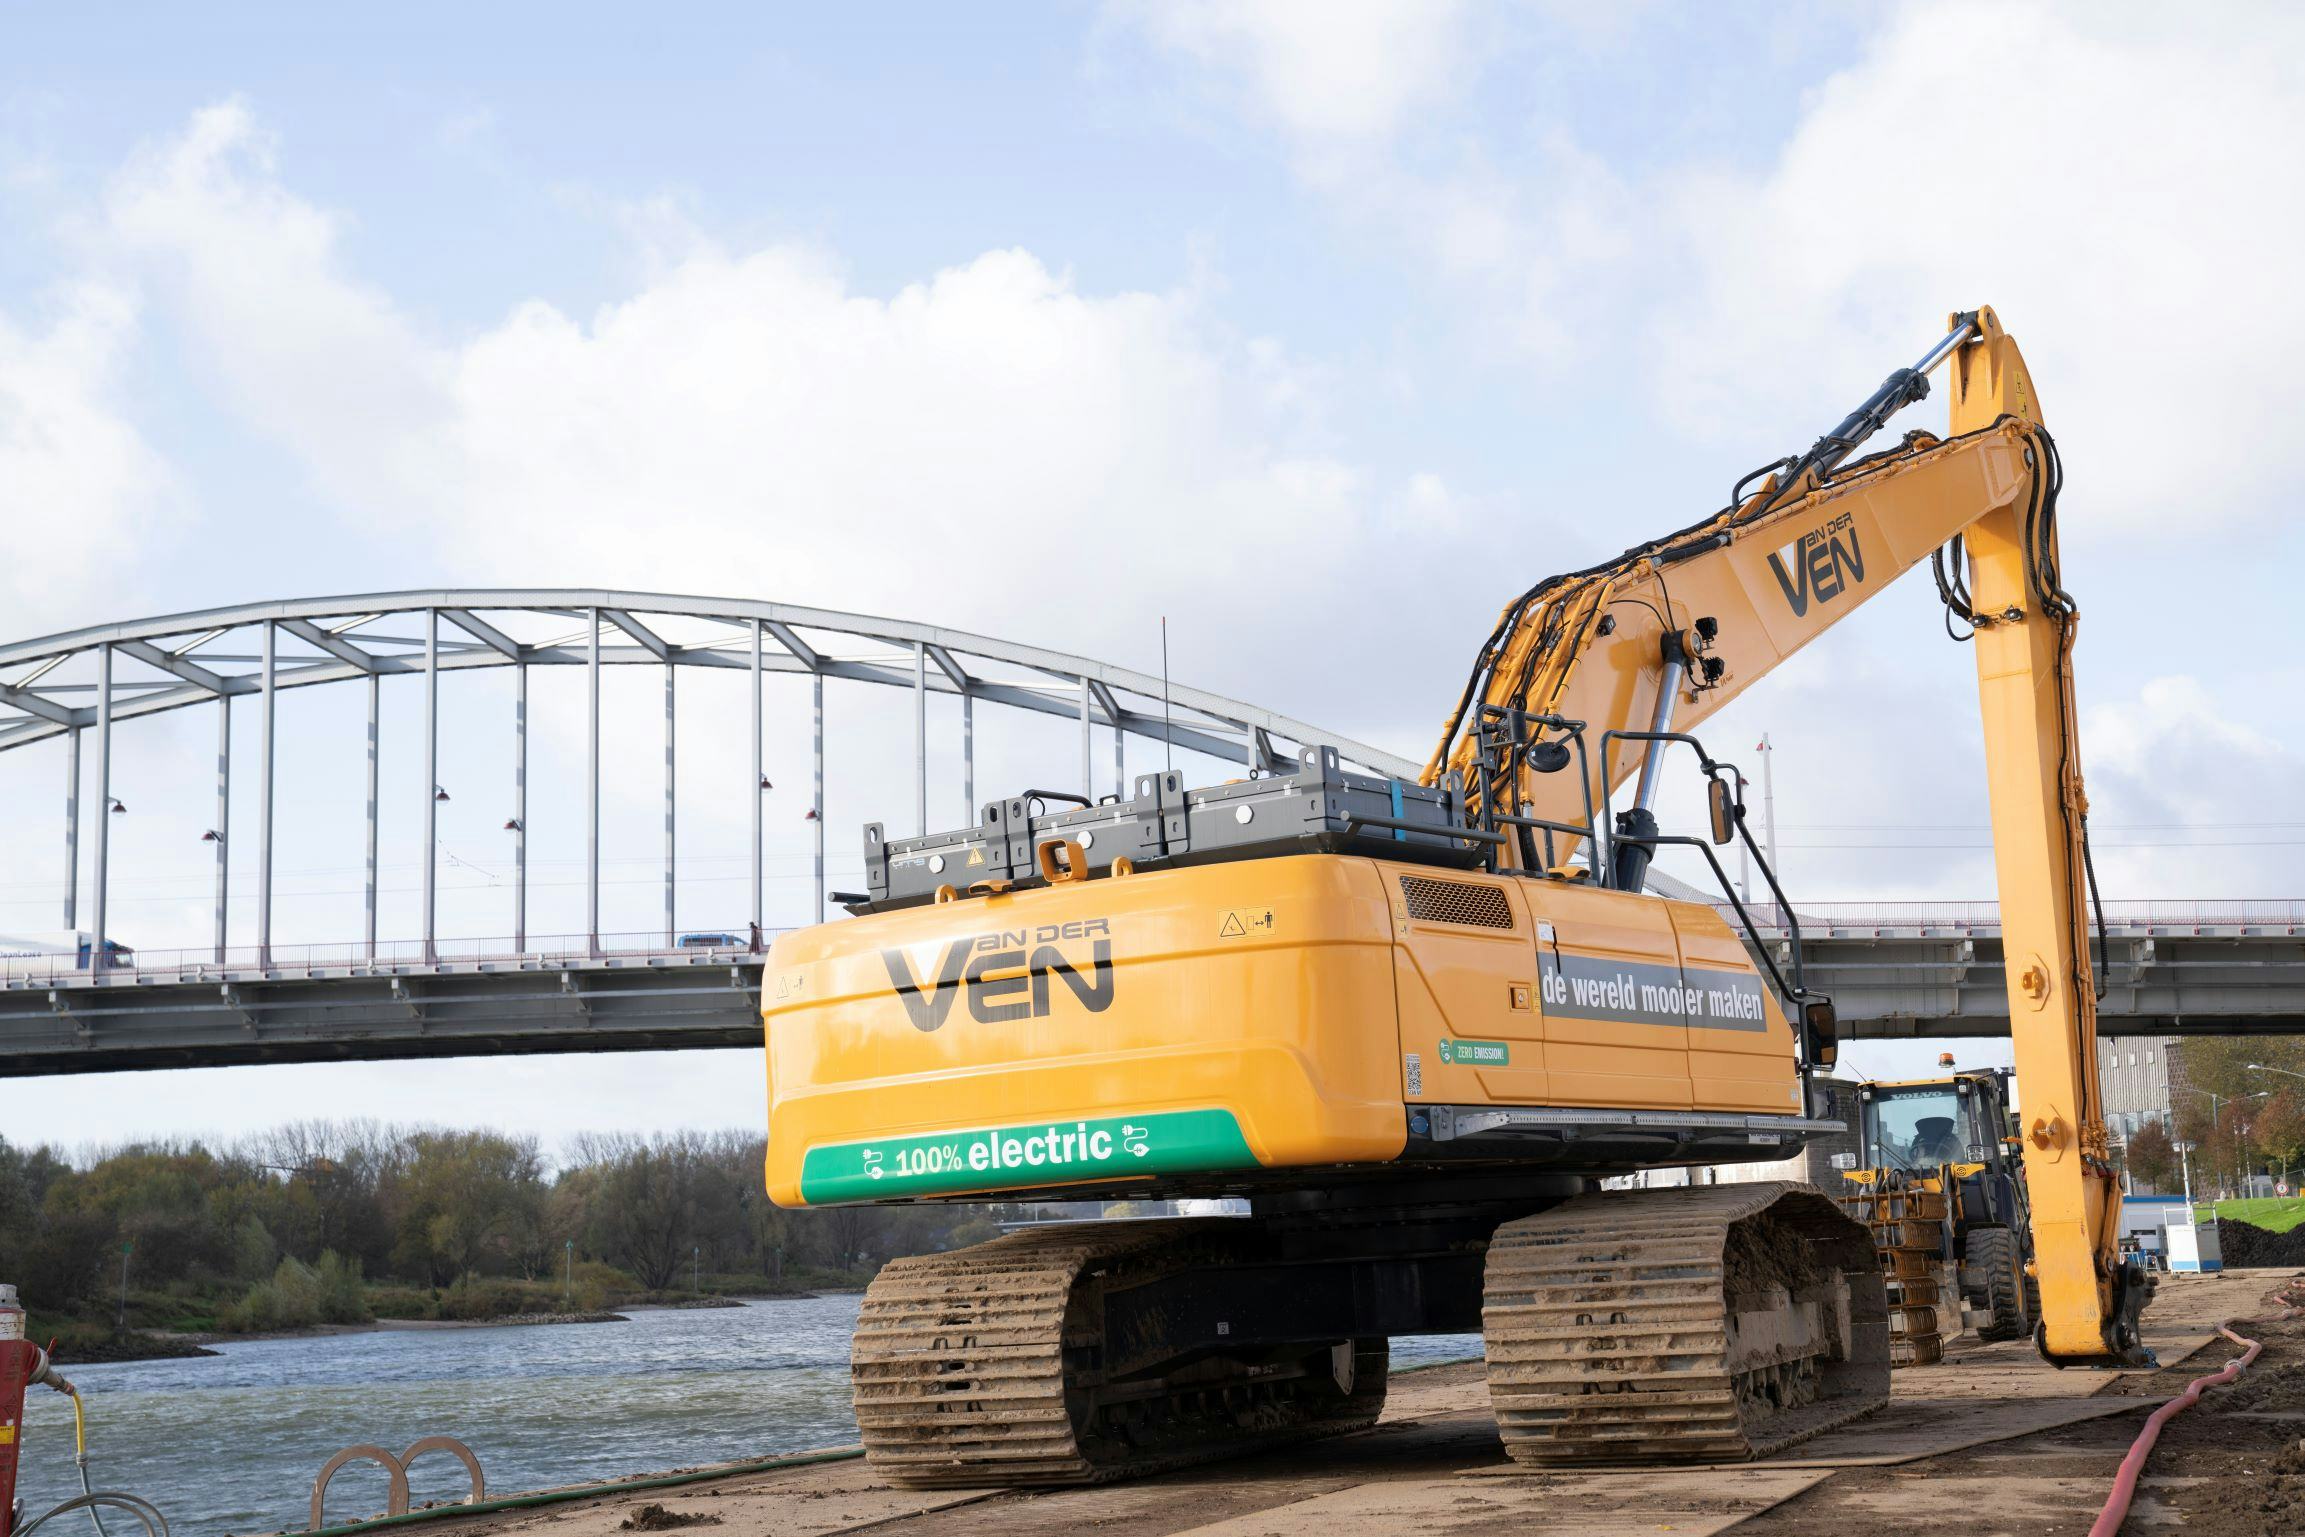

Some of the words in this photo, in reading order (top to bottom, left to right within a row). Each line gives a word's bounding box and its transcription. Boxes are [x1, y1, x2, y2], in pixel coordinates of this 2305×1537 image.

[1826, 512, 1853, 535] DER
[1766, 527, 1864, 617] VEN
[1036, 917, 1110, 944] DER
[880, 937, 1114, 1032] VEN
[1542, 966, 1567, 1005] de
[1571, 973, 1636, 1011] wereld
[1641, 979, 1704, 1016] mooier
[1708, 984, 1763, 1020] maken
[1457, 1046, 1473, 1059] ZERO
[1890, 1091, 1943, 1100] VOLVO
[895, 1143, 963, 1177] 100%
[968, 1122, 1113, 1171] electric
